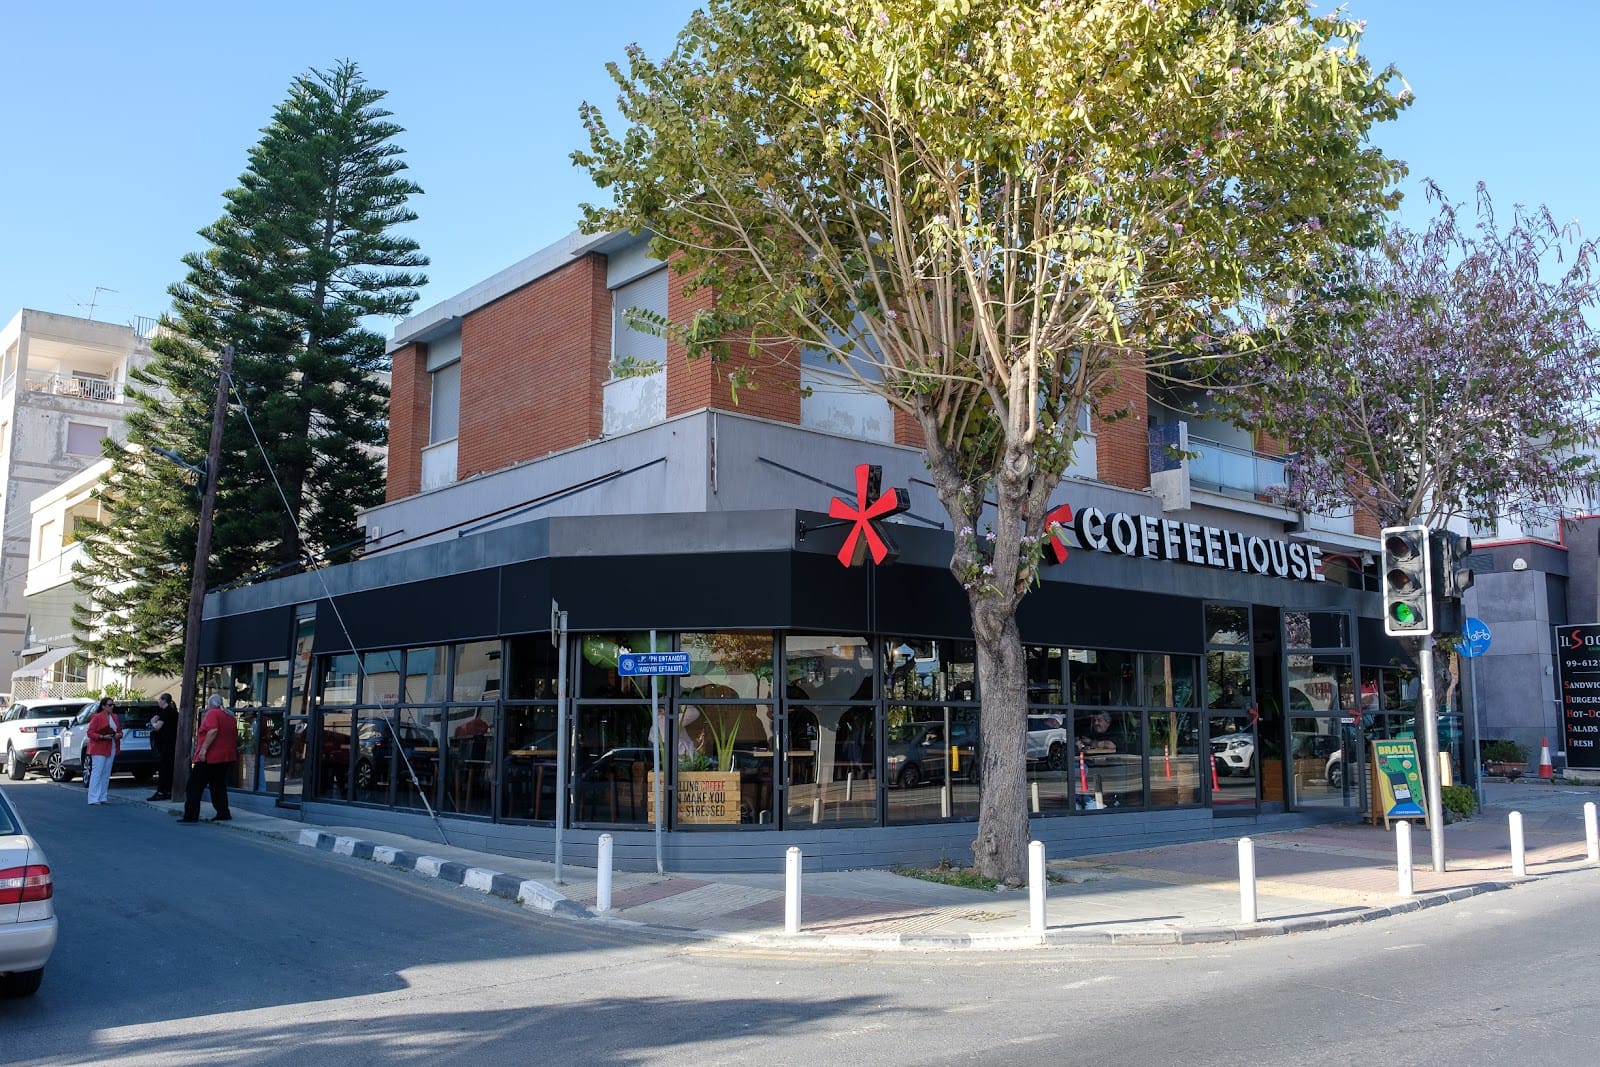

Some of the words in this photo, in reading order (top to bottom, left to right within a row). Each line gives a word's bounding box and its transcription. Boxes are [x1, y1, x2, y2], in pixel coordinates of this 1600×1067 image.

[1077, 506, 1326, 582] COFFEEHOUSE
[1568, 723, 1599, 733] SALADS
[1568, 738, 1594, 747] FRESH
[1378, 744, 1414, 755] BRAZIL
[700, 780, 726, 792] COFFEE
[684, 791, 707, 804] MAKE
[709, 791, 726, 804] YOU
[686, 805, 726, 817] STRESSED
